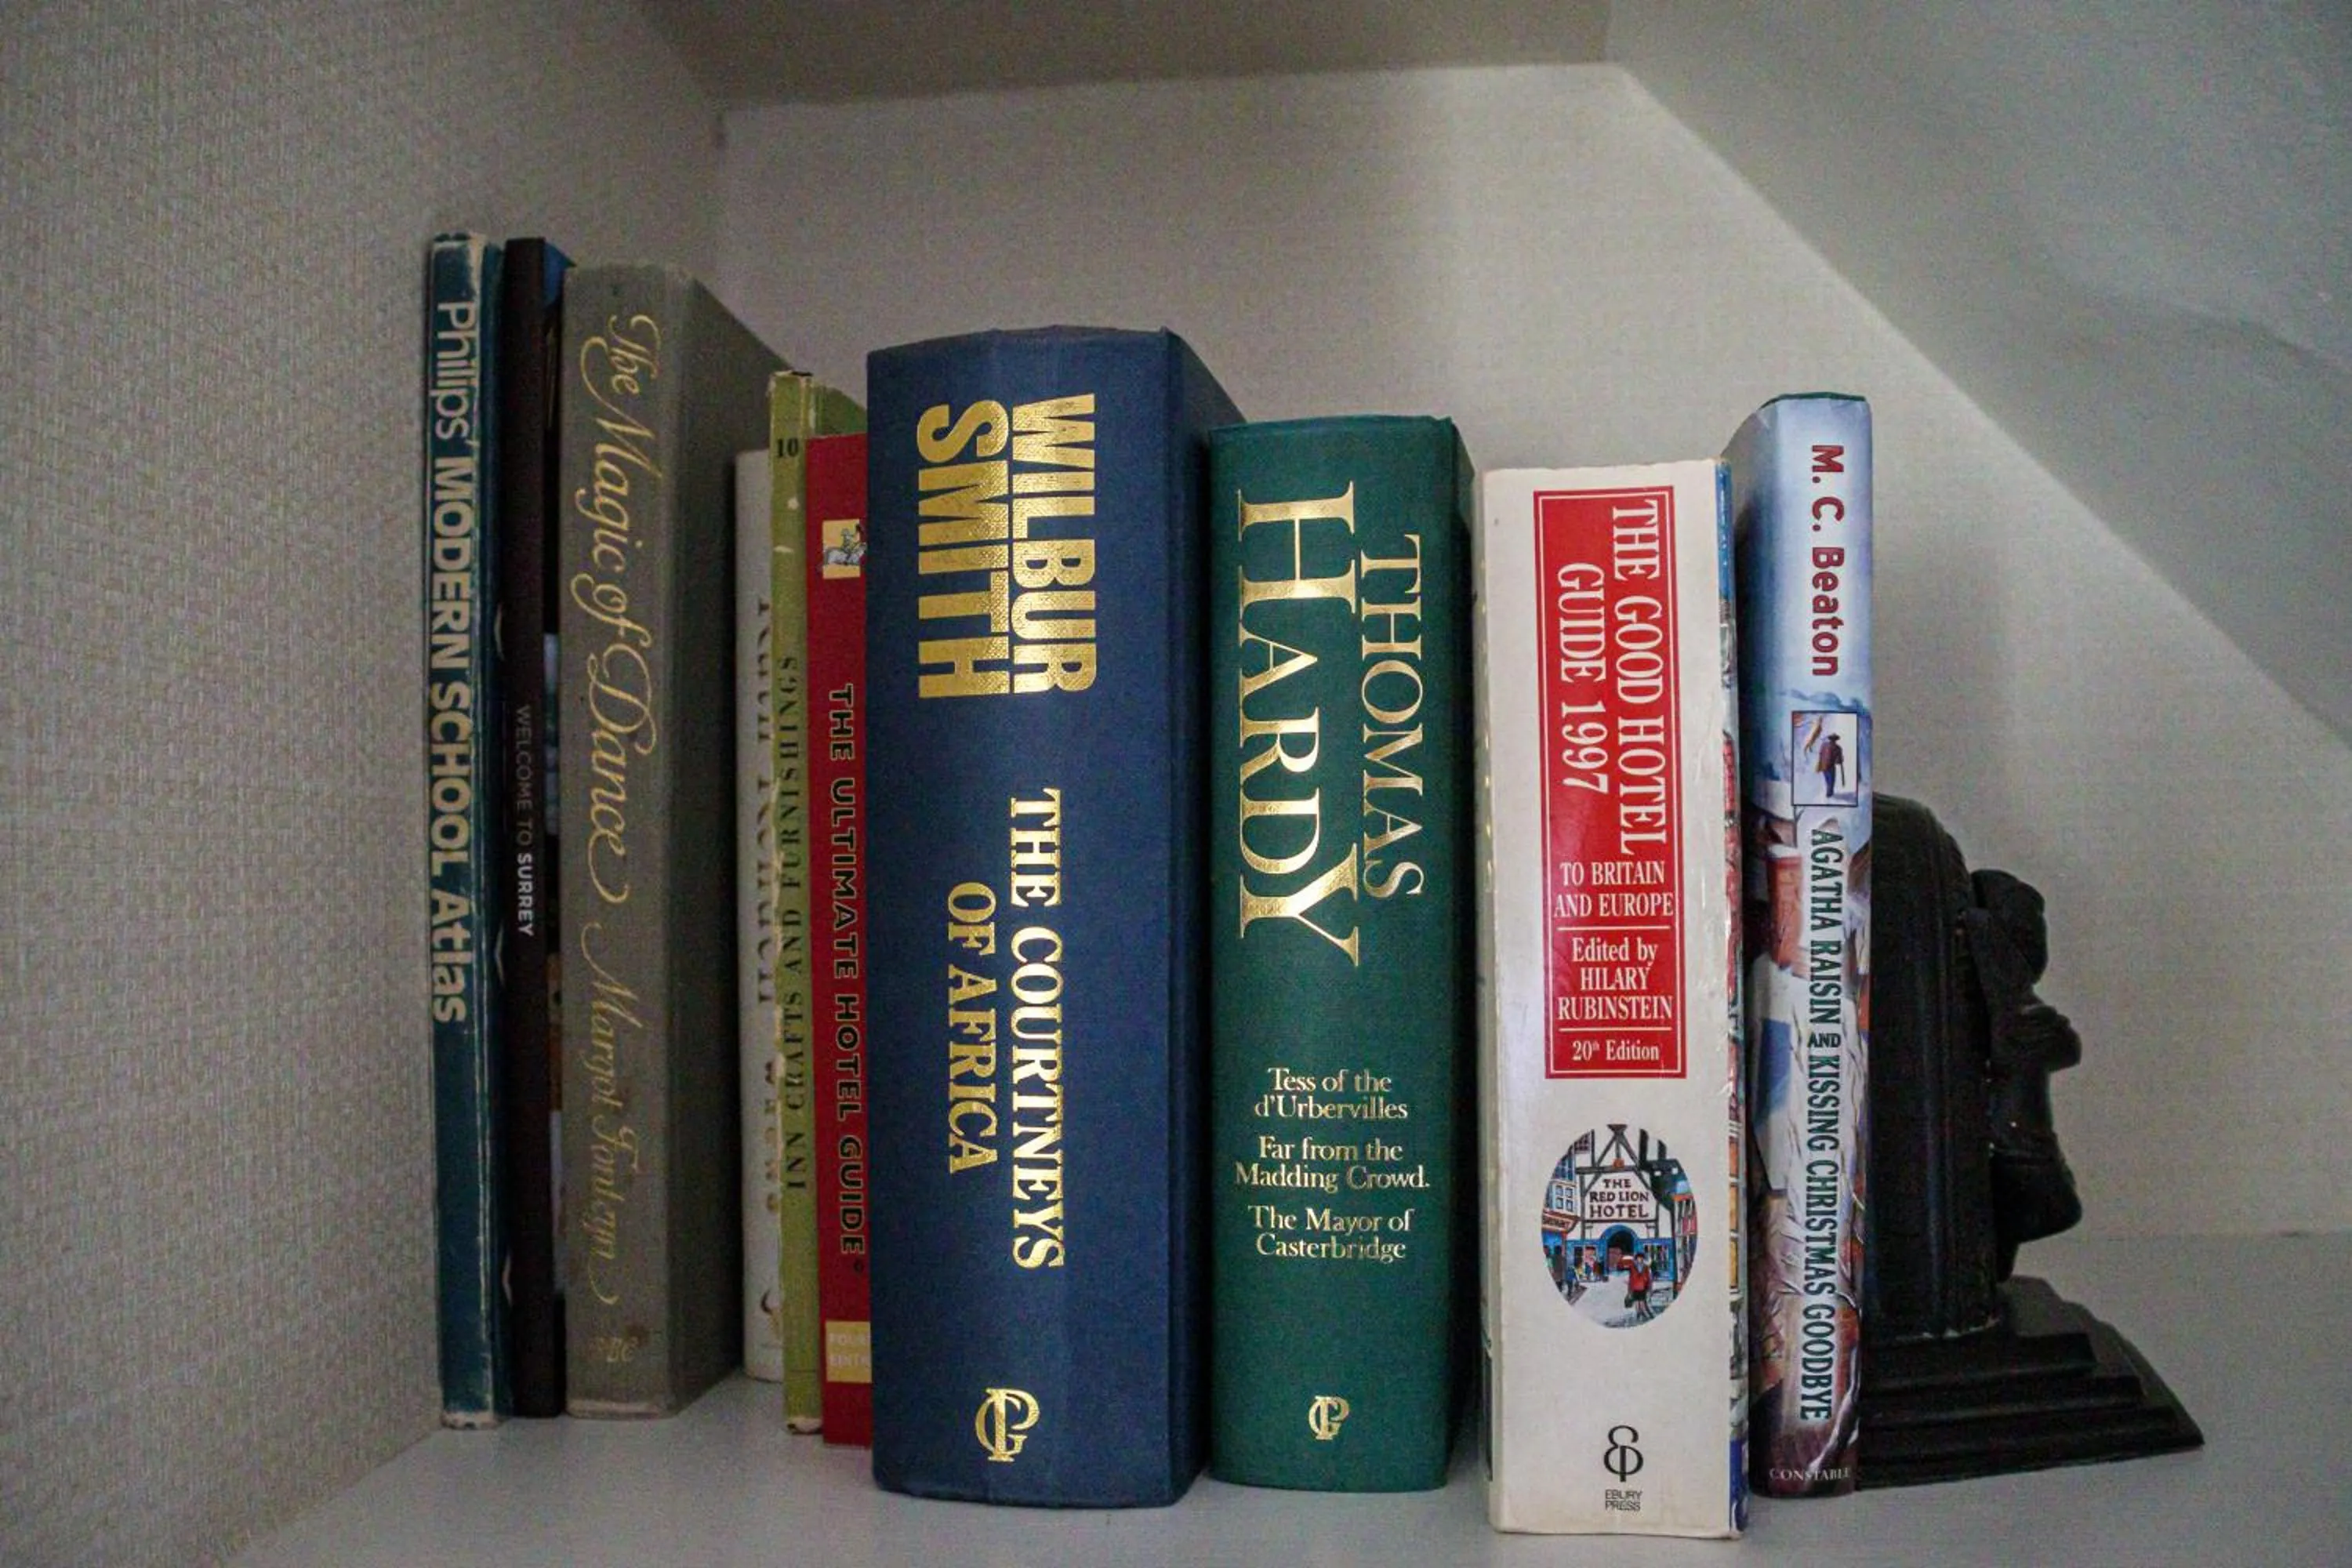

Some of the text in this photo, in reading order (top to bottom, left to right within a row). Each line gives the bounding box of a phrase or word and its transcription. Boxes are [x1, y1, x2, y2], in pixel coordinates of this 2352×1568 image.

[775, 437, 800, 459] 10
[916, 399, 1011, 699] SMITH
[1011, 392, 1097, 694] WILBUR
[430, 456, 471, 669] MODERN
[1811, 444, 1845, 677] M. C. Beaton
[570, 314, 662, 903] The Magic of Dance
[1557, 561, 1610, 795] GUIDE 1997
[1611, 499, 1668, 855] THE GOOD HOTEL
[1237, 480, 1359, 967] HARDY
[1359, 533, 1425, 900] THOMAS
[430, 682, 473, 875] SCHOOL
[514, 706, 534, 938] WELCOME TO SURREY
[1559, 861, 1665, 886] TO BRITAIN
[1554, 892, 1674, 917] AND EUROPE
[779, 655, 807, 1189] INN CRAFTS AND FURNISHINGS
[430, 890, 472, 1023] Atlas
[1571, 936, 1658, 967] Edited by
[829, 683, 864, 1255] THE ULTIMATE HOTEL GUIDE
[1581, 967, 1650, 990] HILARY
[581, 920, 642, 1108] Margot
[1557, 996, 1673, 1020] RUBINSTEIN
[946, 881, 997, 1174] OF AFRICA
[1010, 787, 1065, 1269] THE COURTNEYS
[1572, 1040, 1660, 1061] 20th Edition
[1268, 1067, 1392, 1092] Tess of the
[1254, 1094, 1408, 1119] d'Urbervilles
[1800, 828, 1845, 1421] AGATHA RAISIN AND KISSING CHRISTMAS GOODBYE
[1258, 1136, 1403, 1160] Far from the
[1234, 1162, 1338, 1193] Madding
[1603, 1178, 1632, 1189] THE
[1589, 1191, 1649, 1203] RED LION
[1589, 1204, 1649, 1218] HOTEL
[1248, 1205, 1415, 1236] The Mayor of
[1256, 1232, 1406, 1264] Casterbridge
[1769, 1466, 1851, 1483] CONSTABLE
[1605, 1489, 1643, 1500] EBURY
[1605, 1500, 1641, 1512] PRESS
